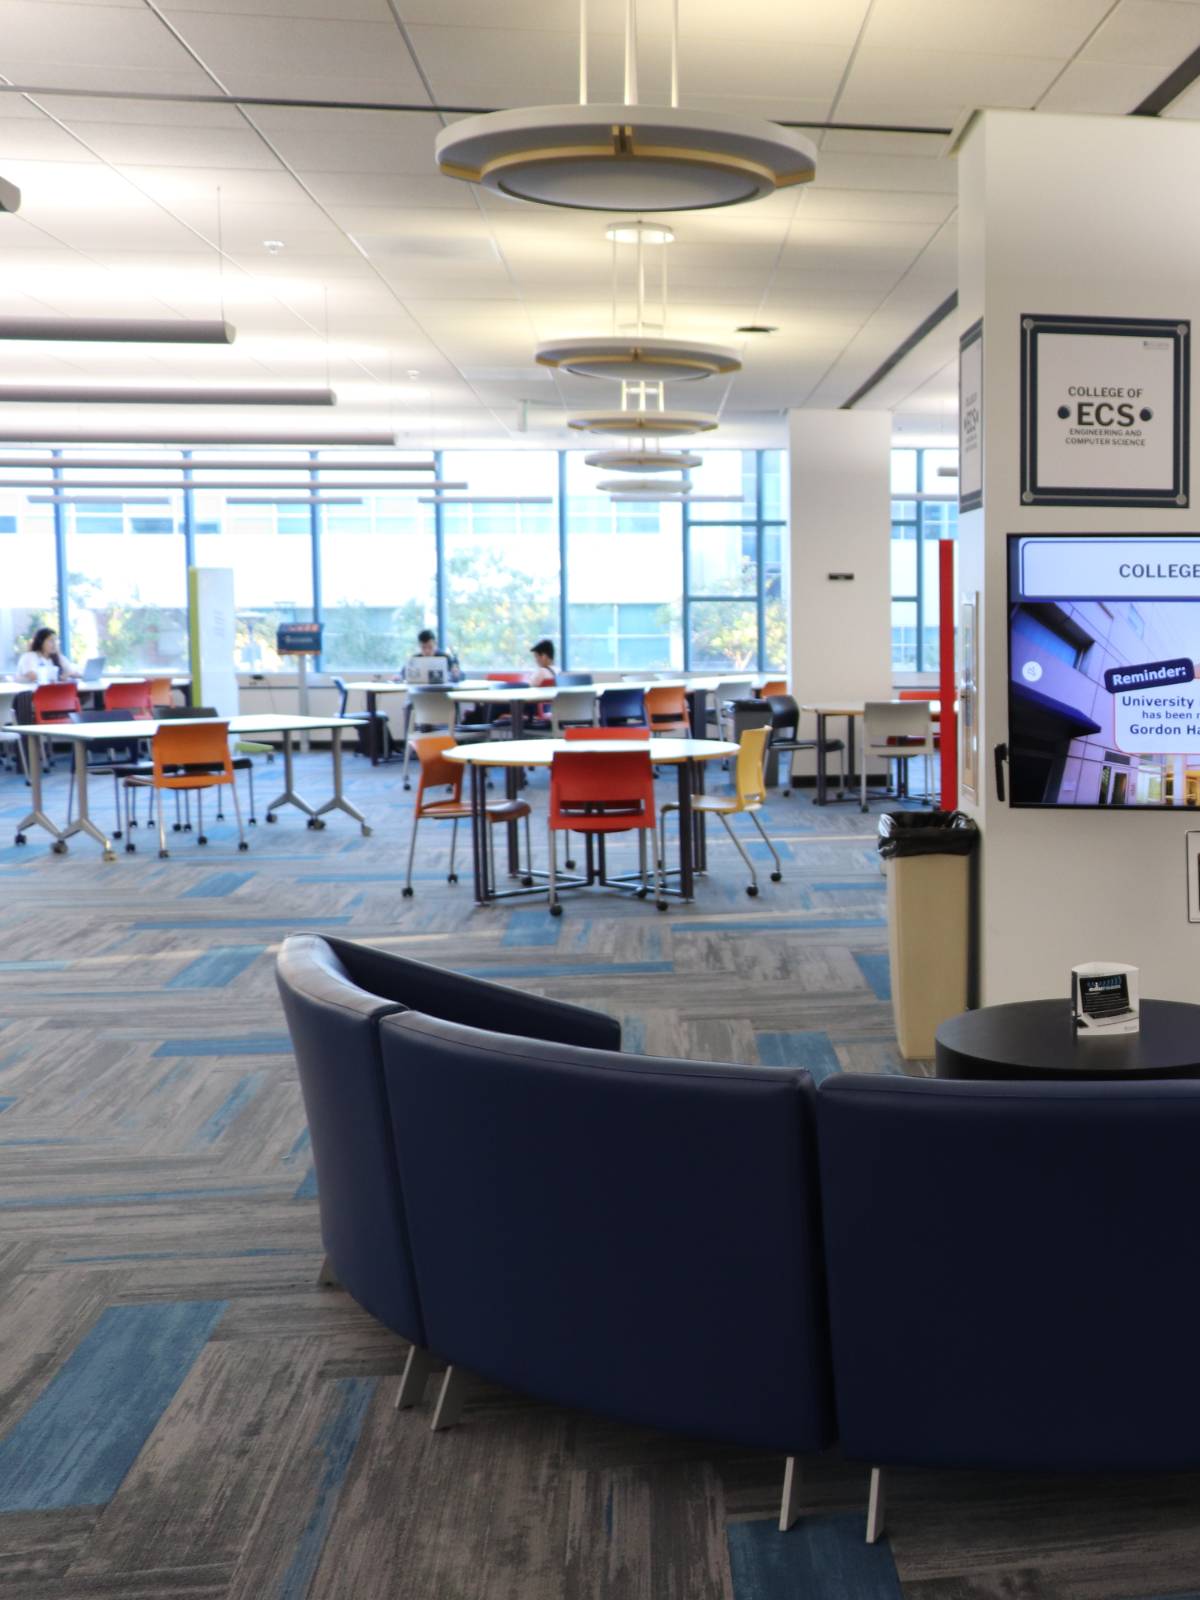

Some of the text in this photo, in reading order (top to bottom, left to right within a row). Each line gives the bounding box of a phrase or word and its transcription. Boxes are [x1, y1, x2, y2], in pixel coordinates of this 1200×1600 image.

[1068, 386, 1143, 398] COLLEGE OF
[1077, 402, 1135, 427] ECS
[1069, 428, 1142, 437] ENGINEERING AND
[1065, 437, 1146, 447] COMPUTER SCIENCE
[1112, 665, 1187, 686] Reminder:
[1122, 695, 1194, 709] University
[1142, 710, 1162, 719] has
[1165, 710, 1193, 720] been
[1129, 724, 1181, 735] Gordon
